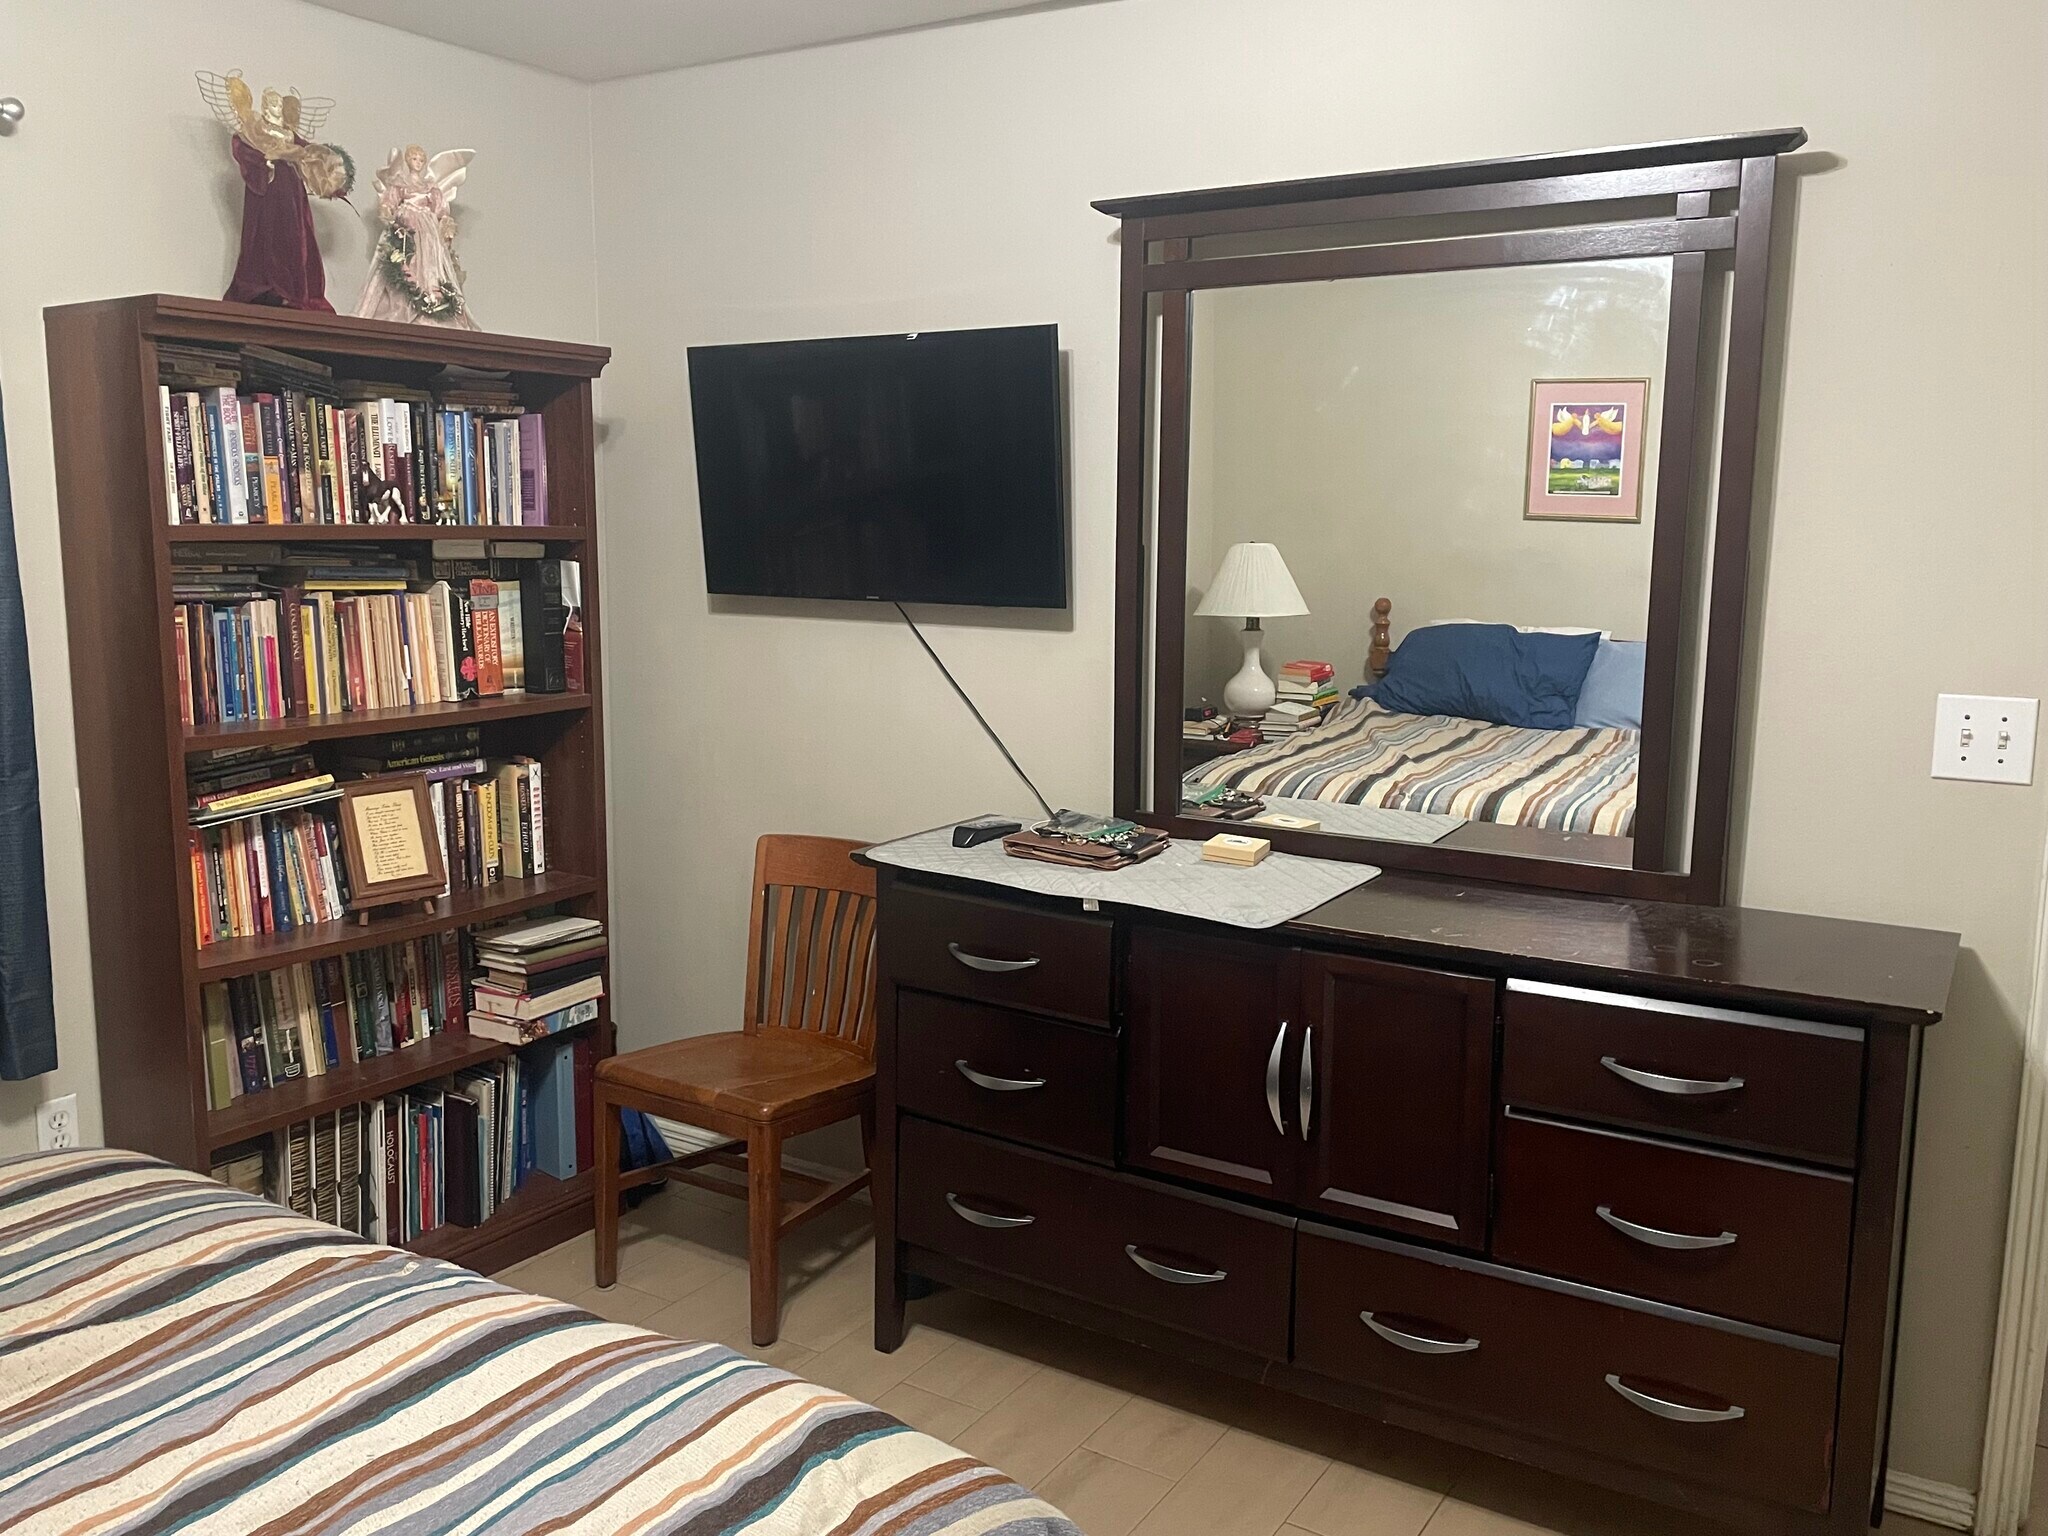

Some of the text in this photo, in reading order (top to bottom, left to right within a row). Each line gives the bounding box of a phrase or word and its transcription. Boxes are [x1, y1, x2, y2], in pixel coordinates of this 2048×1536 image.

[222, 395, 231, 425] THE BOOK
[299, 412, 308, 432] LIVING
[371, 413, 379, 426] THE
[242, 413, 252, 446] TRUTH
[301, 432, 310, 443] ON
[386, 416, 395, 436] LOVE
[266, 430, 274, 455] TRUTH
[302, 443, 310, 454] THE
[320, 436, 328, 458] EARTH
[303, 454, 313, 479] RAGGED
[349, 452, 357, 475] Christ
[387, 444, 397, 479] RESPECT
[180, 484, 188, 507] STANLEY
[252, 476, 261, 509] PEARCEY
[270, 480, 279, 512] PEARCEY
[472, 583, 497, 596] VINE
[289, 602, 301, 662] CONCORDANCE
[460, 627, 469, 652] Revised
[474, 610, 486, 671] BIBLICAL WORDS
[480, 610, 492, 664] DICTIONARY OF
[488, 610, 499, 667] AN EXPOSITORY
[386, 752, 446, 769] American Genesis
[438, 764, 451, 773] East
[450, 763, 462, 771] and
[455, 793, 464, 813] BOOK
[485, 792, 494, 825] KINGDOM
[519, 782, 528, 814] HOSSEINI
[456, 817, 466, 853] MYSTERIES
[521, 821, 531, 853] ECHOED
[488, 839, 497, 860] CULTS
[446, 952, 461, 1008] EINSTEIN
[245, 1054, 256, 1076] 1776
[386, 1129, 395, 1186] HOLOCAUST
